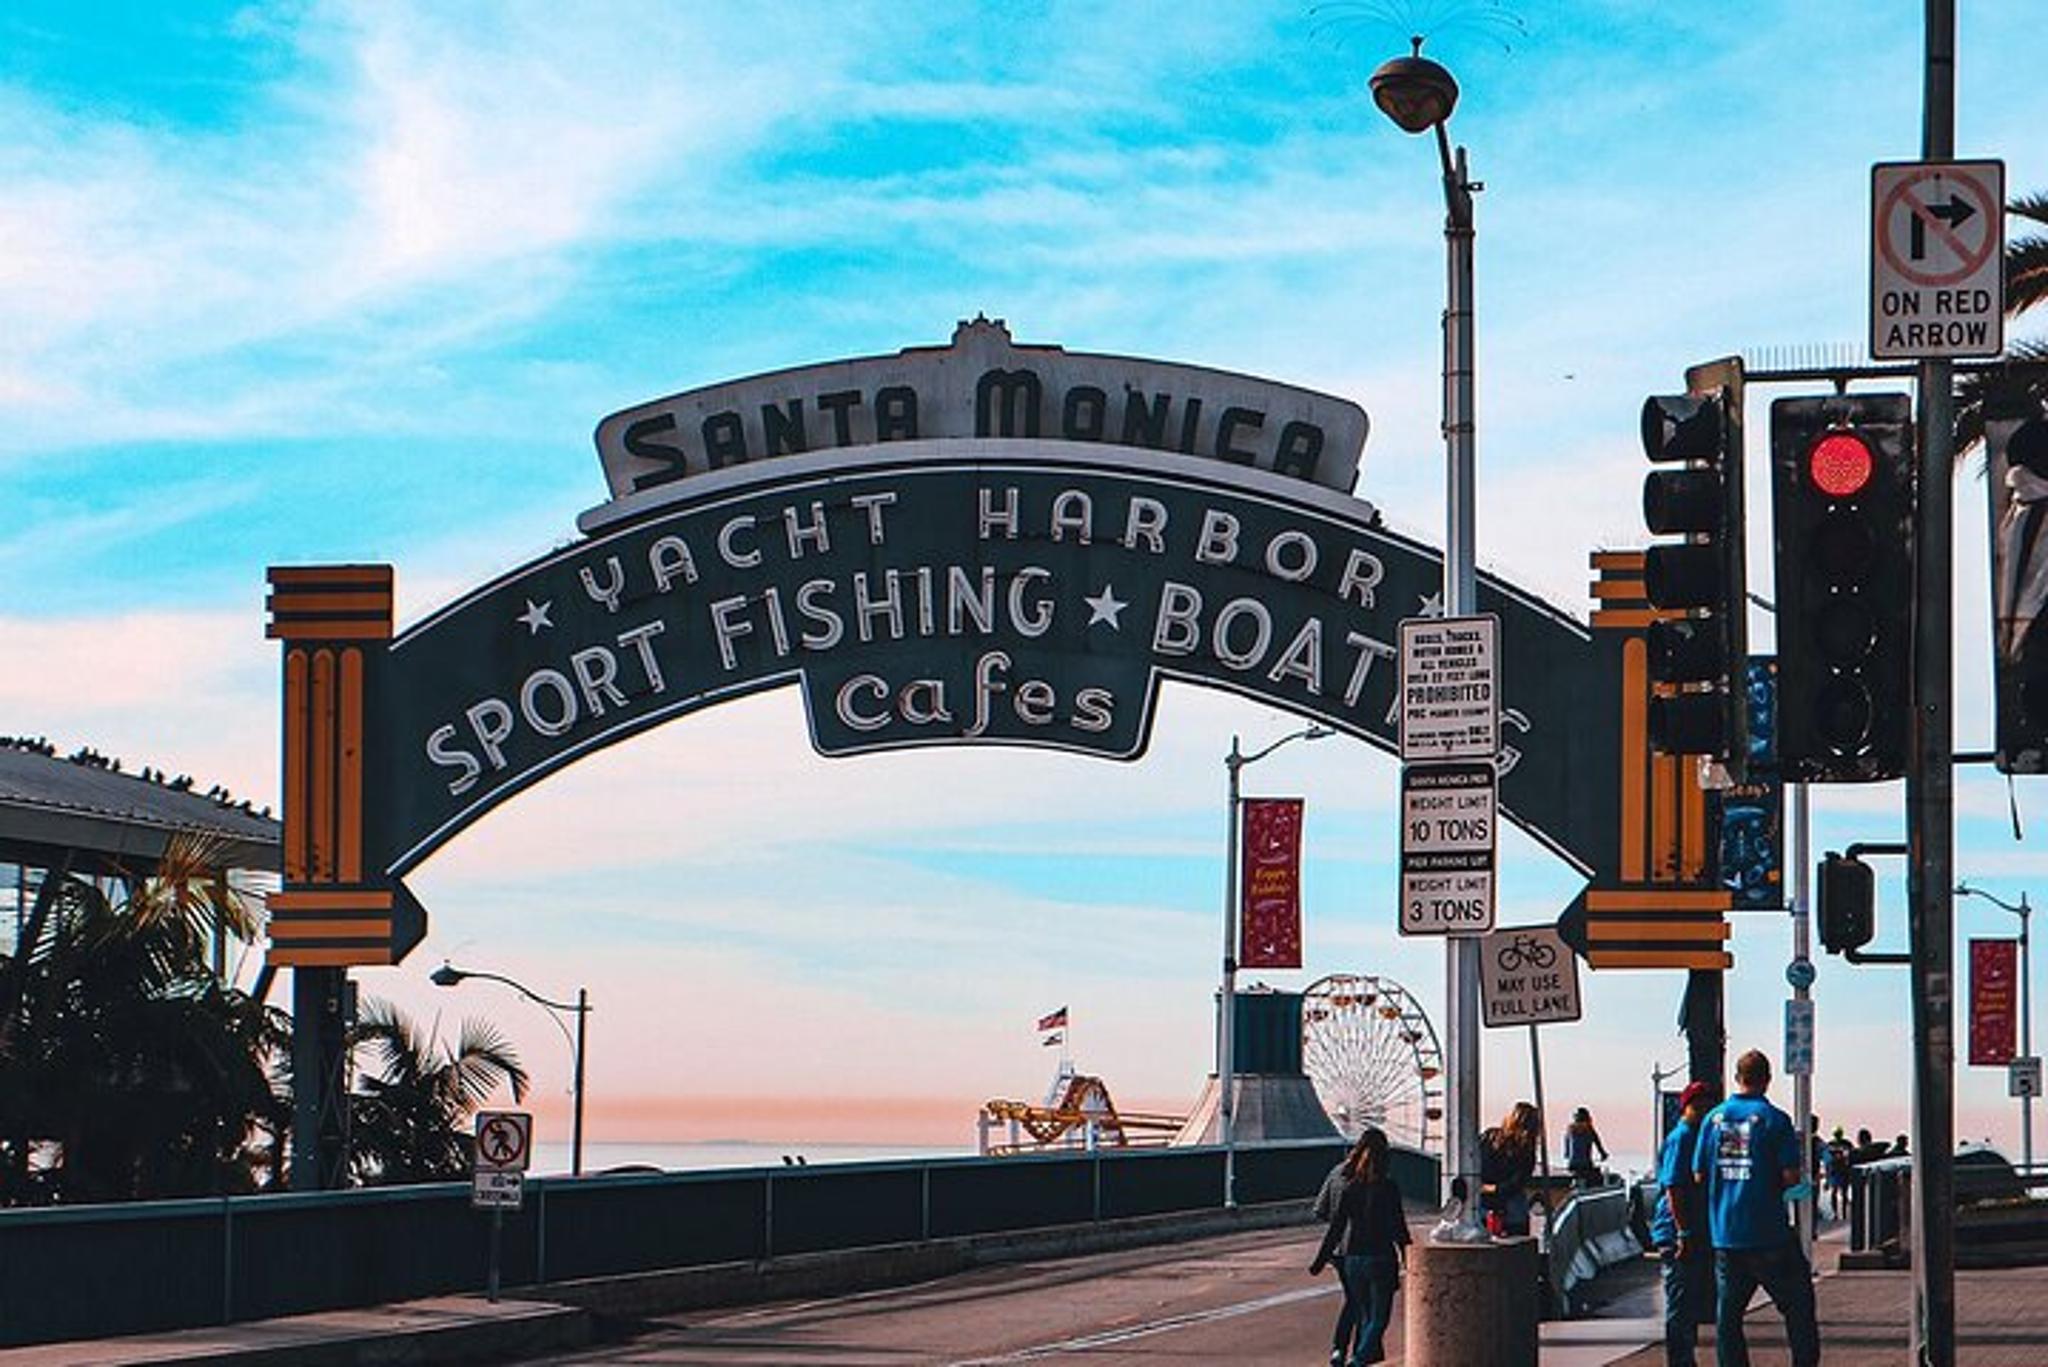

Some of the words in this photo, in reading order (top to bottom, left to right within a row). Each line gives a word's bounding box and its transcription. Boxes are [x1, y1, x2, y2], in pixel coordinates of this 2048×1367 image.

[1882, 290, 1919, 316] ON
[1936, 289, 1990, 315] RED
[1886, 321, 1987, 347] ARROW
[623, 385, 918, 493] SANTA
[975, 368, 1324, 483] MONICA
[580, 491, 897, 612] YACHT
[978, 487, 1384, 608] HARBOR
[426, 619, 666, 796] SPORT
[711, 566, 1055, 670] FISHING
[836, 651, 1114, 738] cafes
[1407, 684, 1490, 703] PROHIBITED
[1410, 796, 1454, 811] WEIGHT
[1458, 795, 1488, 810] LIMIT
[1410, 819, 1431, 841] 10
[1437, 818, 1488, 841] TONS
[1409, 878, 1452, 892] WEIGHT
[1457, 876, 1487, 891] LIMIT
[1409, 900, 1423, 922] 3
[1430, 899, 1485, 921] TONS
[1498, 977, 1525, 993] MAY
[1531, 974, 1561, 991] USE
[1492, 999, 1527, 1017] FULL
[1532, 994, 1571, 1012] LANE
